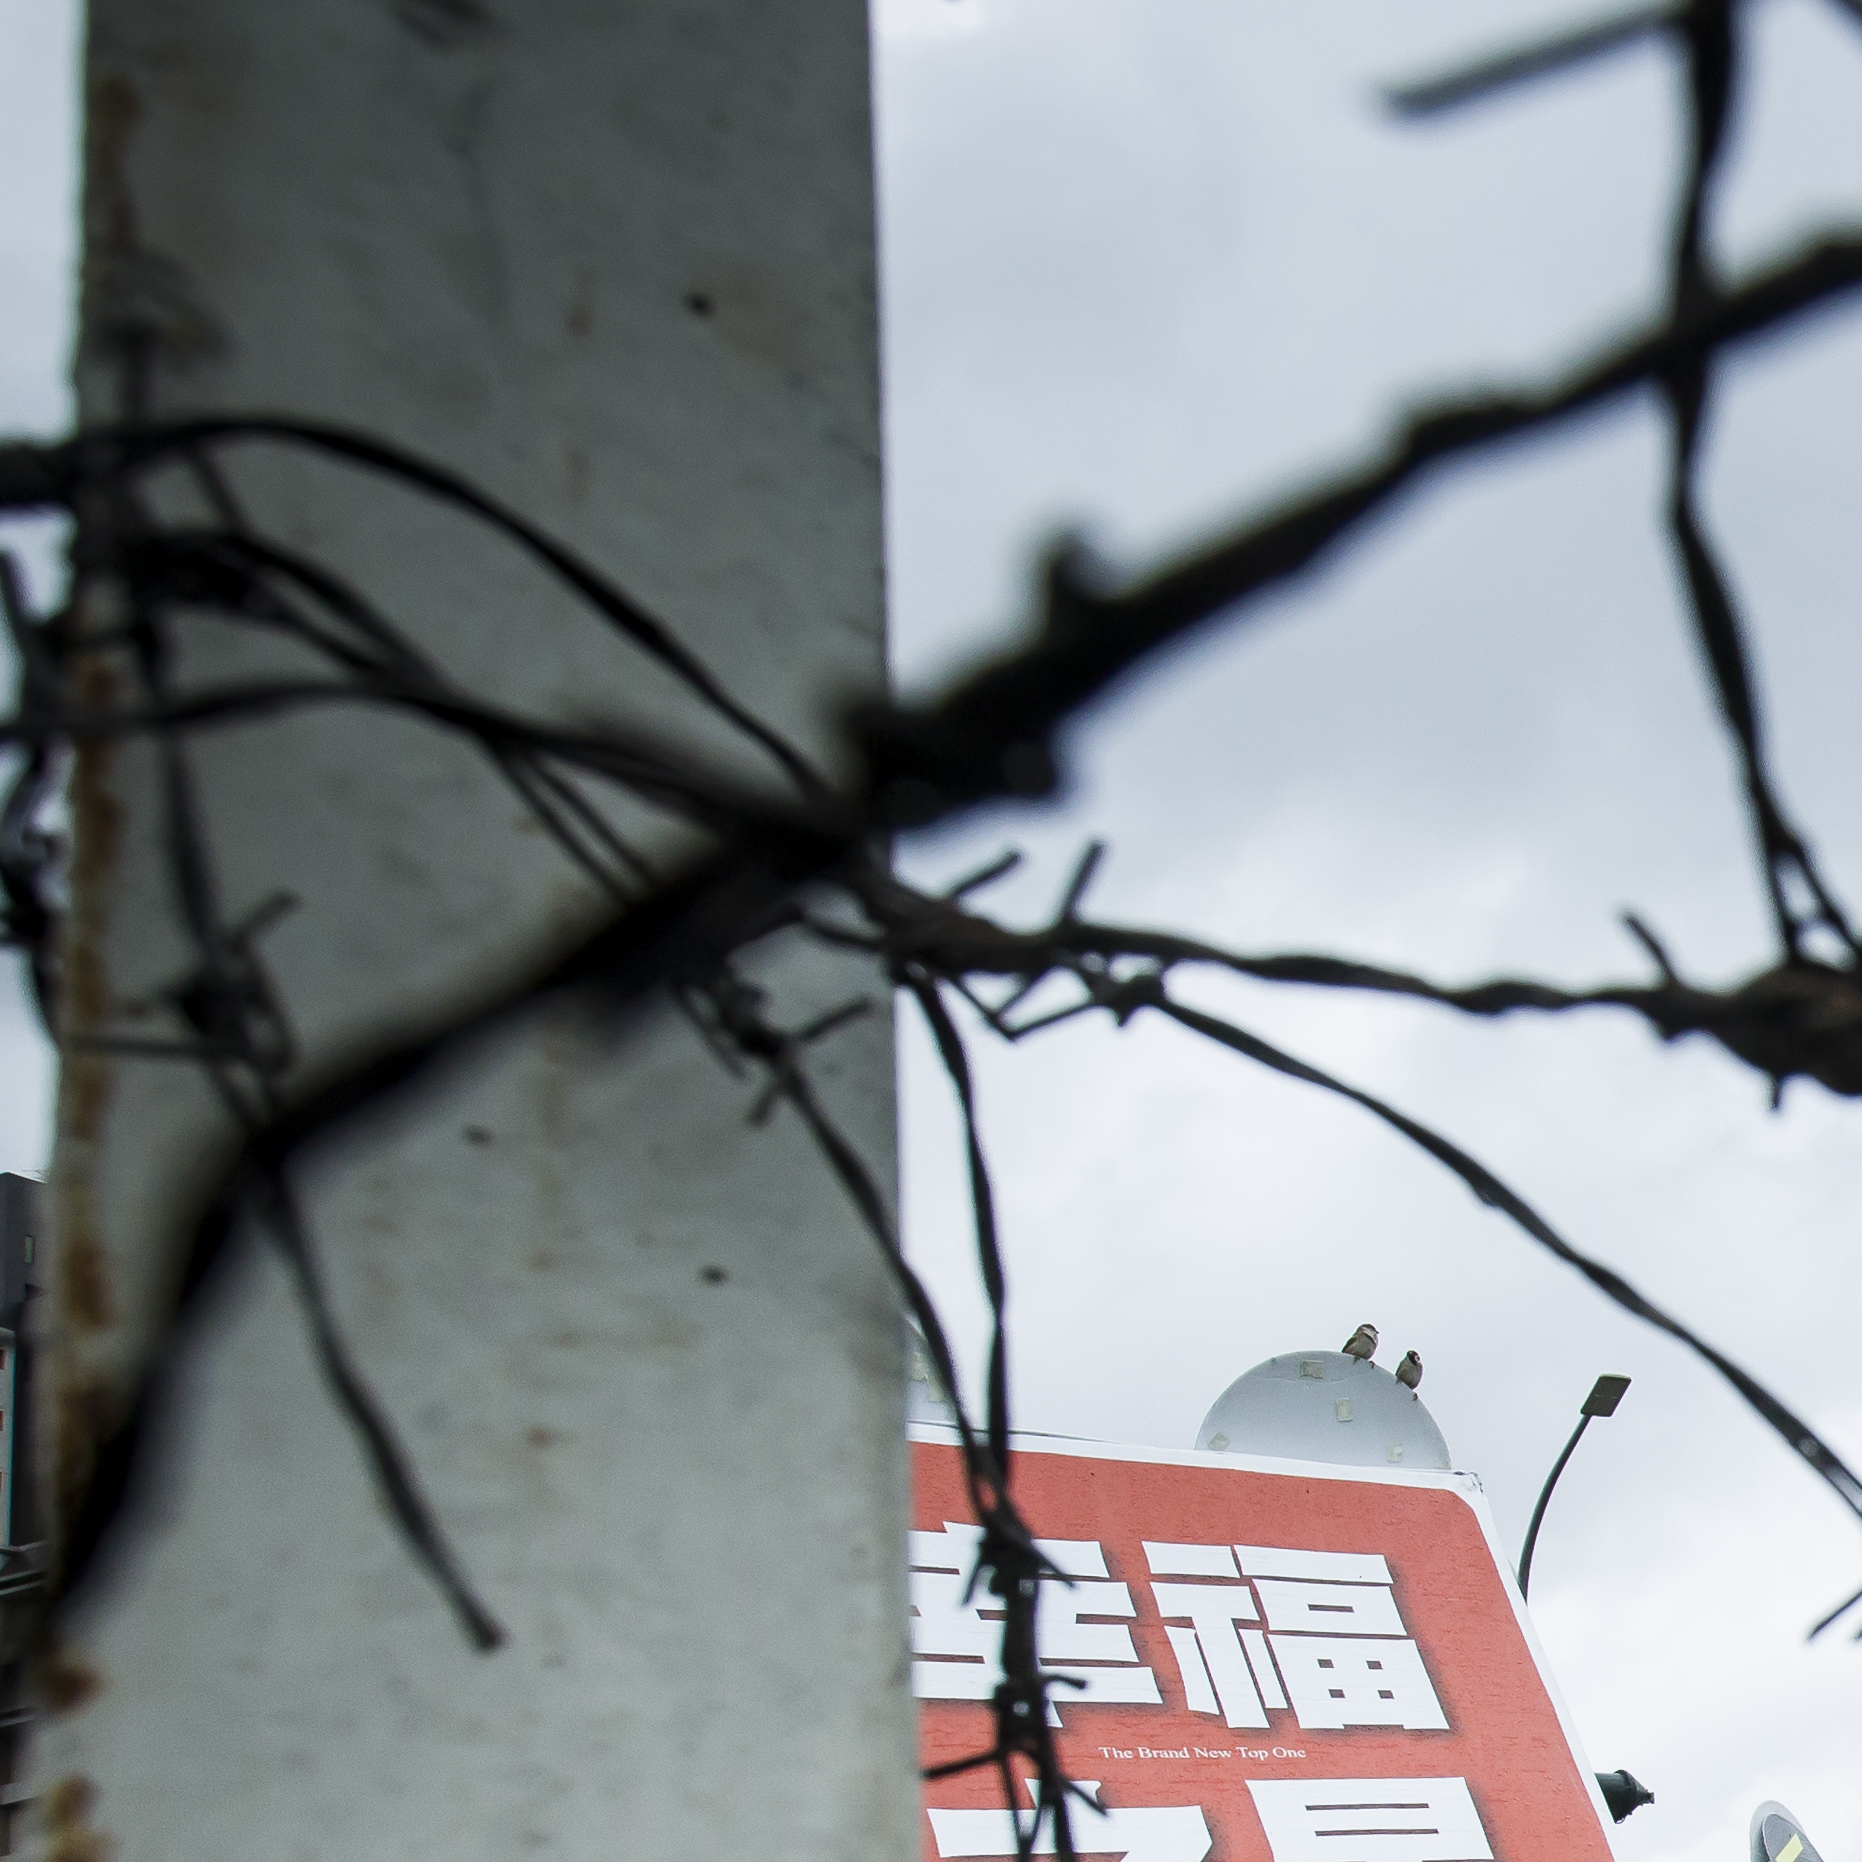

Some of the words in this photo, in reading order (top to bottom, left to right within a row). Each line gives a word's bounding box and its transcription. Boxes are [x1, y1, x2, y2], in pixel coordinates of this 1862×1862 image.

[907, 1519, 1451, 1731] 幸福
[1098, 1746, 1134, 1759] The
[1136, 1746, 1191, 1760] Brand
[1193, 1746, 1233, 1759] New
[1235, 1746, 1269, 1762] Top
[1271, 1746, 1308, 1759] One
